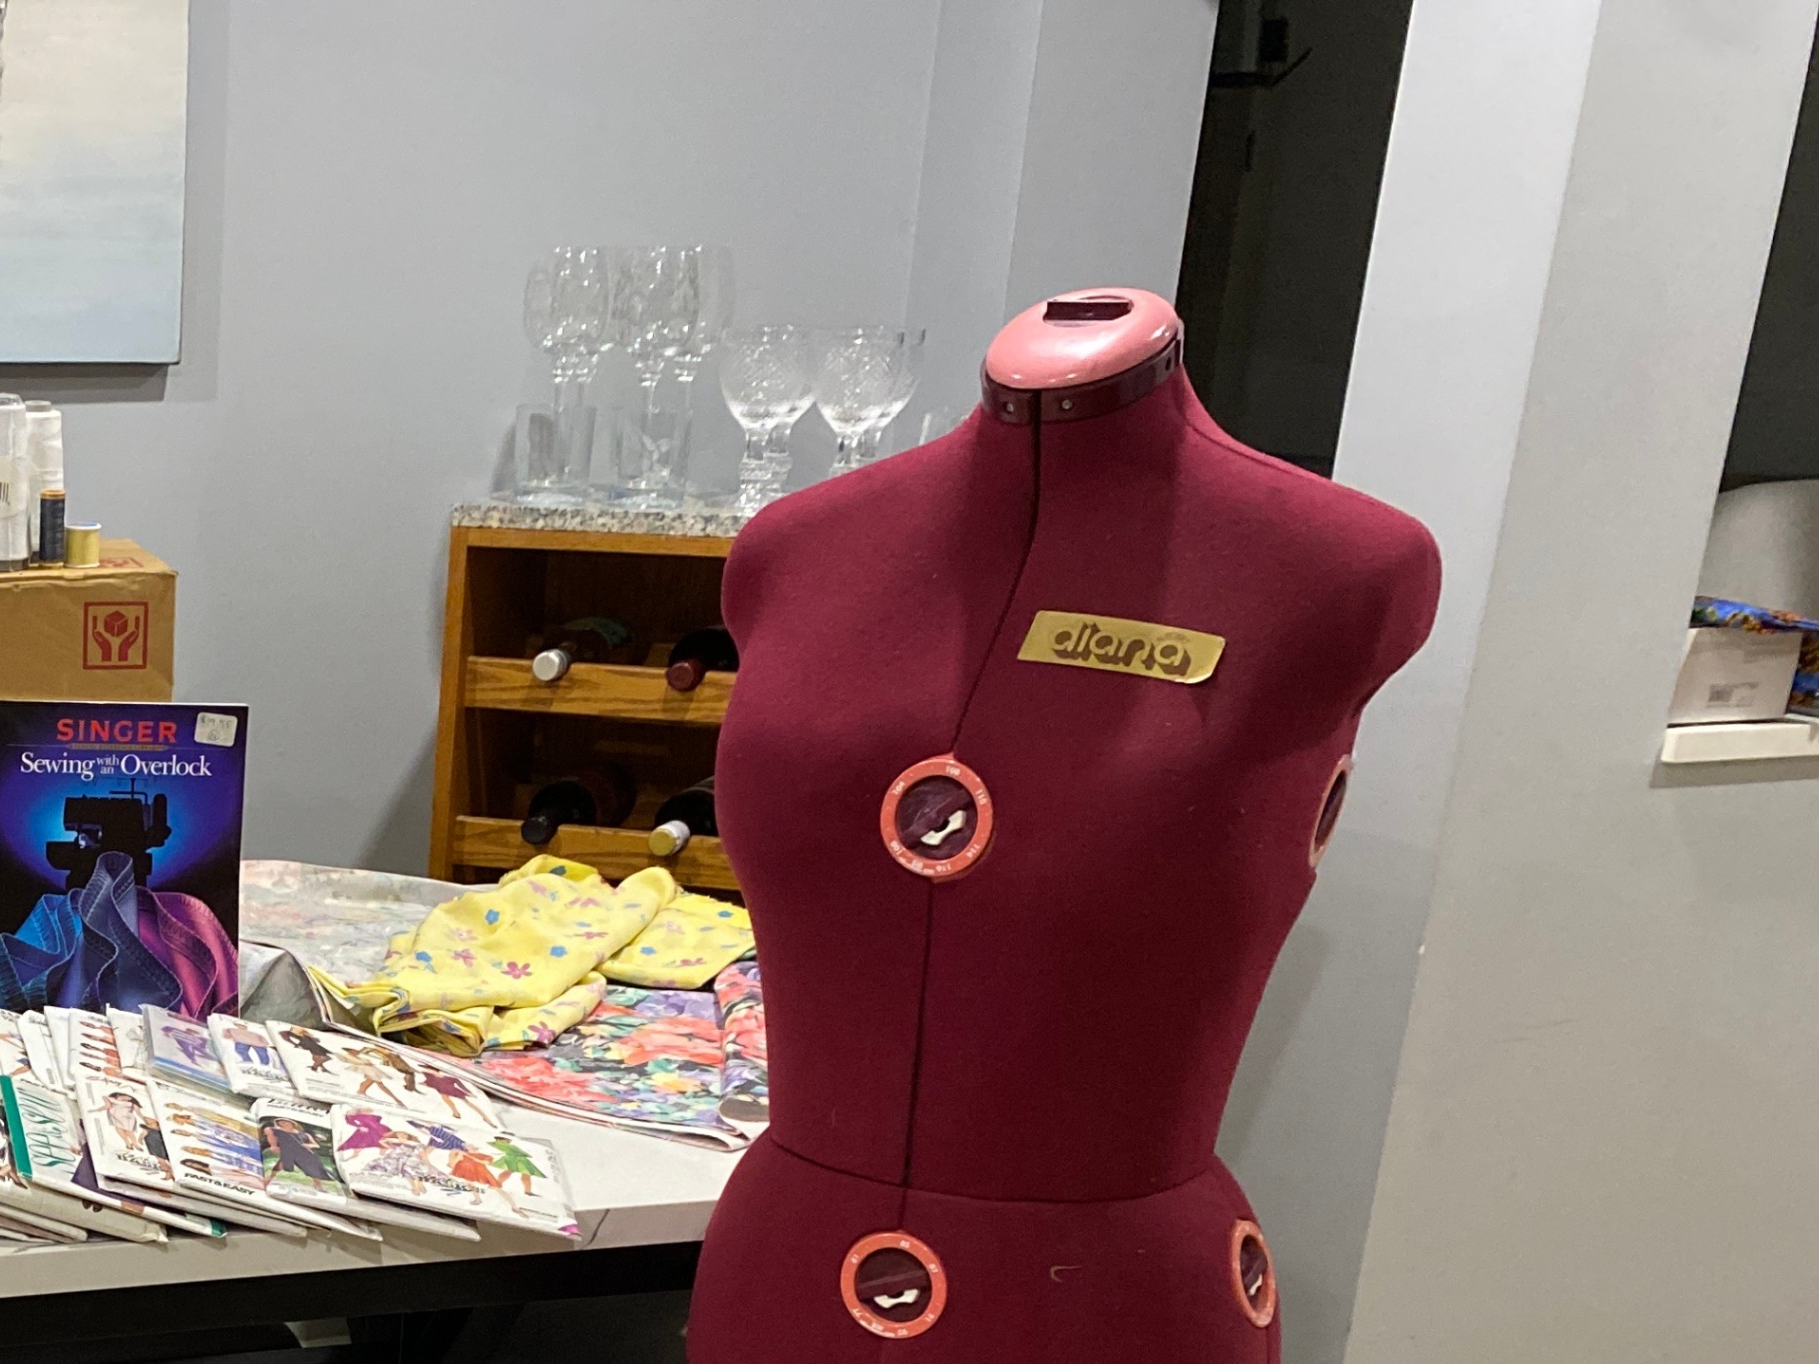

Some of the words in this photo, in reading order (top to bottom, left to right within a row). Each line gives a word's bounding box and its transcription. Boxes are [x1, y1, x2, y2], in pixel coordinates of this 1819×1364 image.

[1052, 621, 1192, 677] diana
[56, 718, 178, 744] SINGER
[21, 752, 95, 781] Sewing
[97, 755, 119, 767] with
[120, 754, 212, 777] Overlock
[100, 766, 115, 775] an
